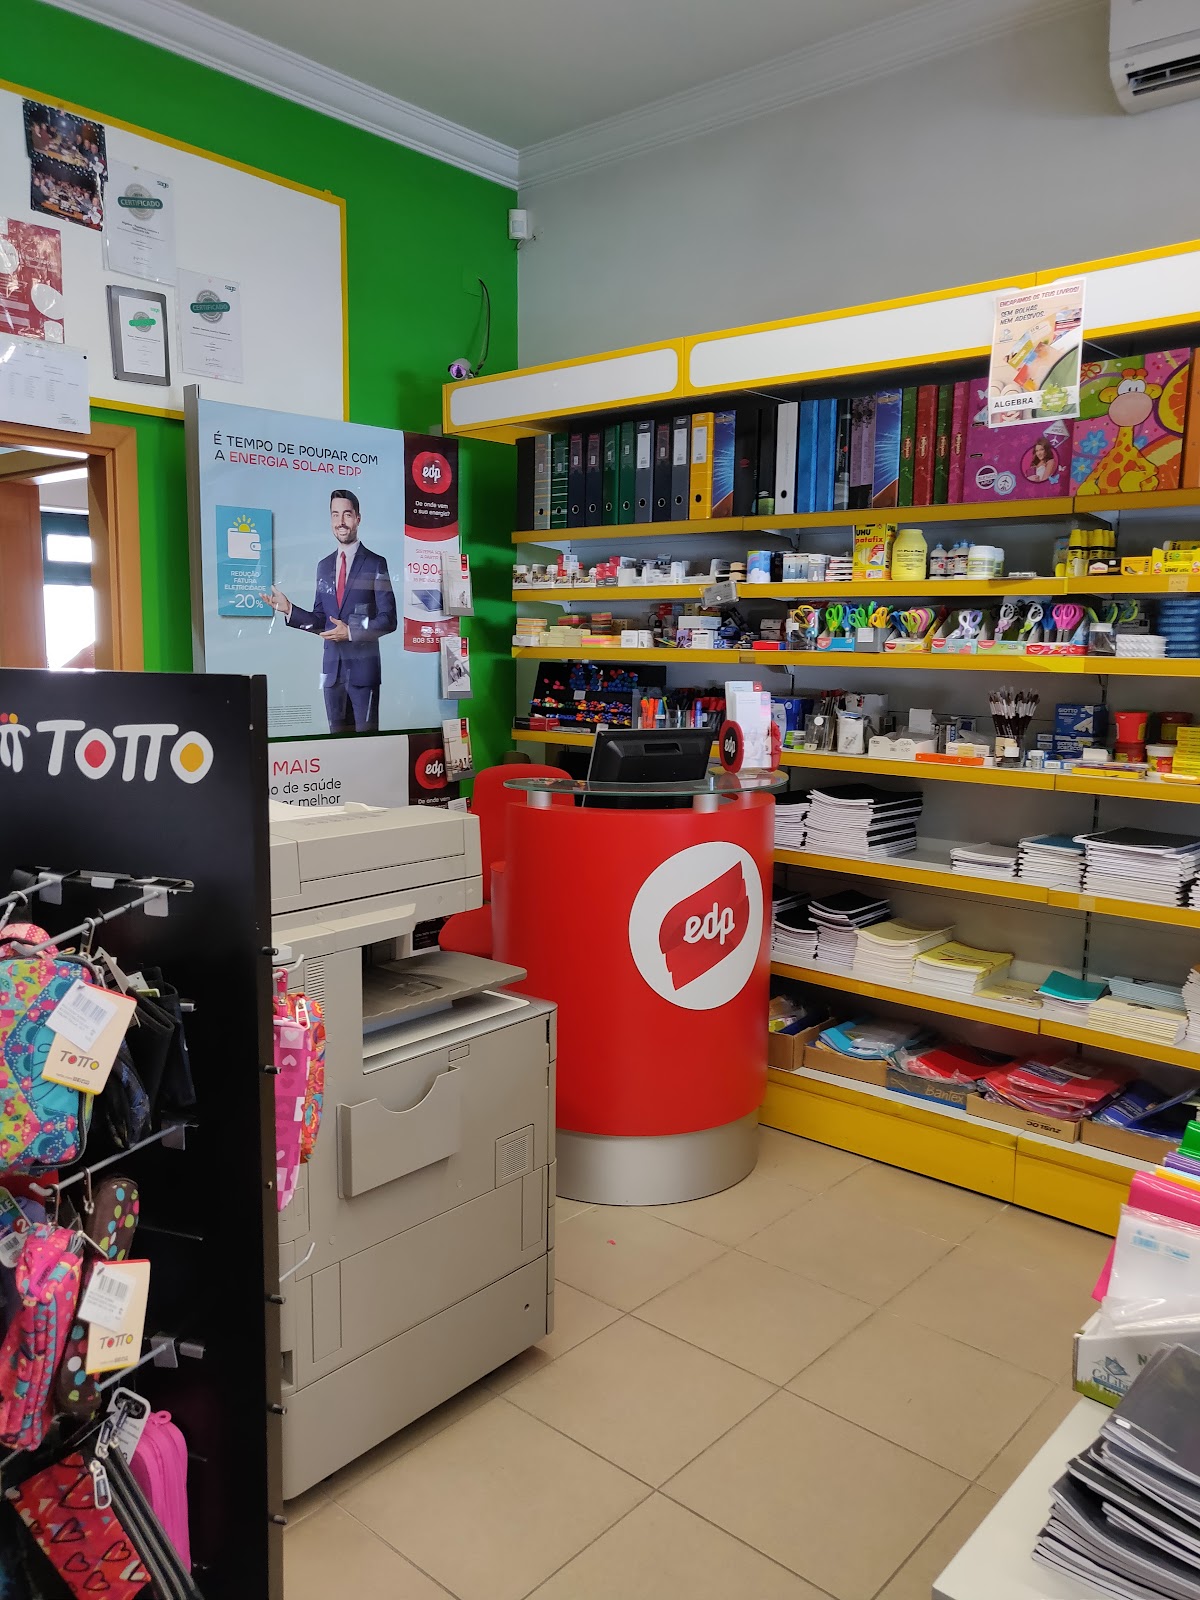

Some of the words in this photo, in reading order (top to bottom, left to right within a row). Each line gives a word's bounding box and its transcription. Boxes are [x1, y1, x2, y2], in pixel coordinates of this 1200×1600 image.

[120, 199, 161, 208] CERTIFICADO
[192, 303, 228, 311] CERTIFICADO
[994, 397, 1034, 409] ALGEBRA
[213, 430, 222, 446] É
[226, 435, 273, 452] TEMPO
[277, 442, 295, 455] DE
[299, 445, 348, 462] POUPAR
[351, 452, 378, 465] COM
[214, 449, 225, 461] A
[230, 451, 289, 468] ENERGIA
[292, 459, 335, 474] SOLAR
[338, 464, 362, 477] EDP
[422, 464, 441, 482] edp
[429, 510, 450, 518] energia?
[230, 570, 260, 578] REDUÇÃO
[228, 594, 264, 609] -20%
[36, 719, 214, 784] TOTTO
[724, 736, 736, 758] edp
[273, 758, 321, 776] MAIS
[424, 760, 444, 777] edp
[283, 782, 299, 794] de
[303, 777, 342, 792] saúde
[298, 794, 341, 807] melhor
[683, 902, 735, 945] edp
[59, 1050, 100, 1071] TOTTO
[924, 1084, 965, 1105] Bantex
[16, 1218, 30, 1233] 2
[99, 1333, 134, 1350] TOTTO
